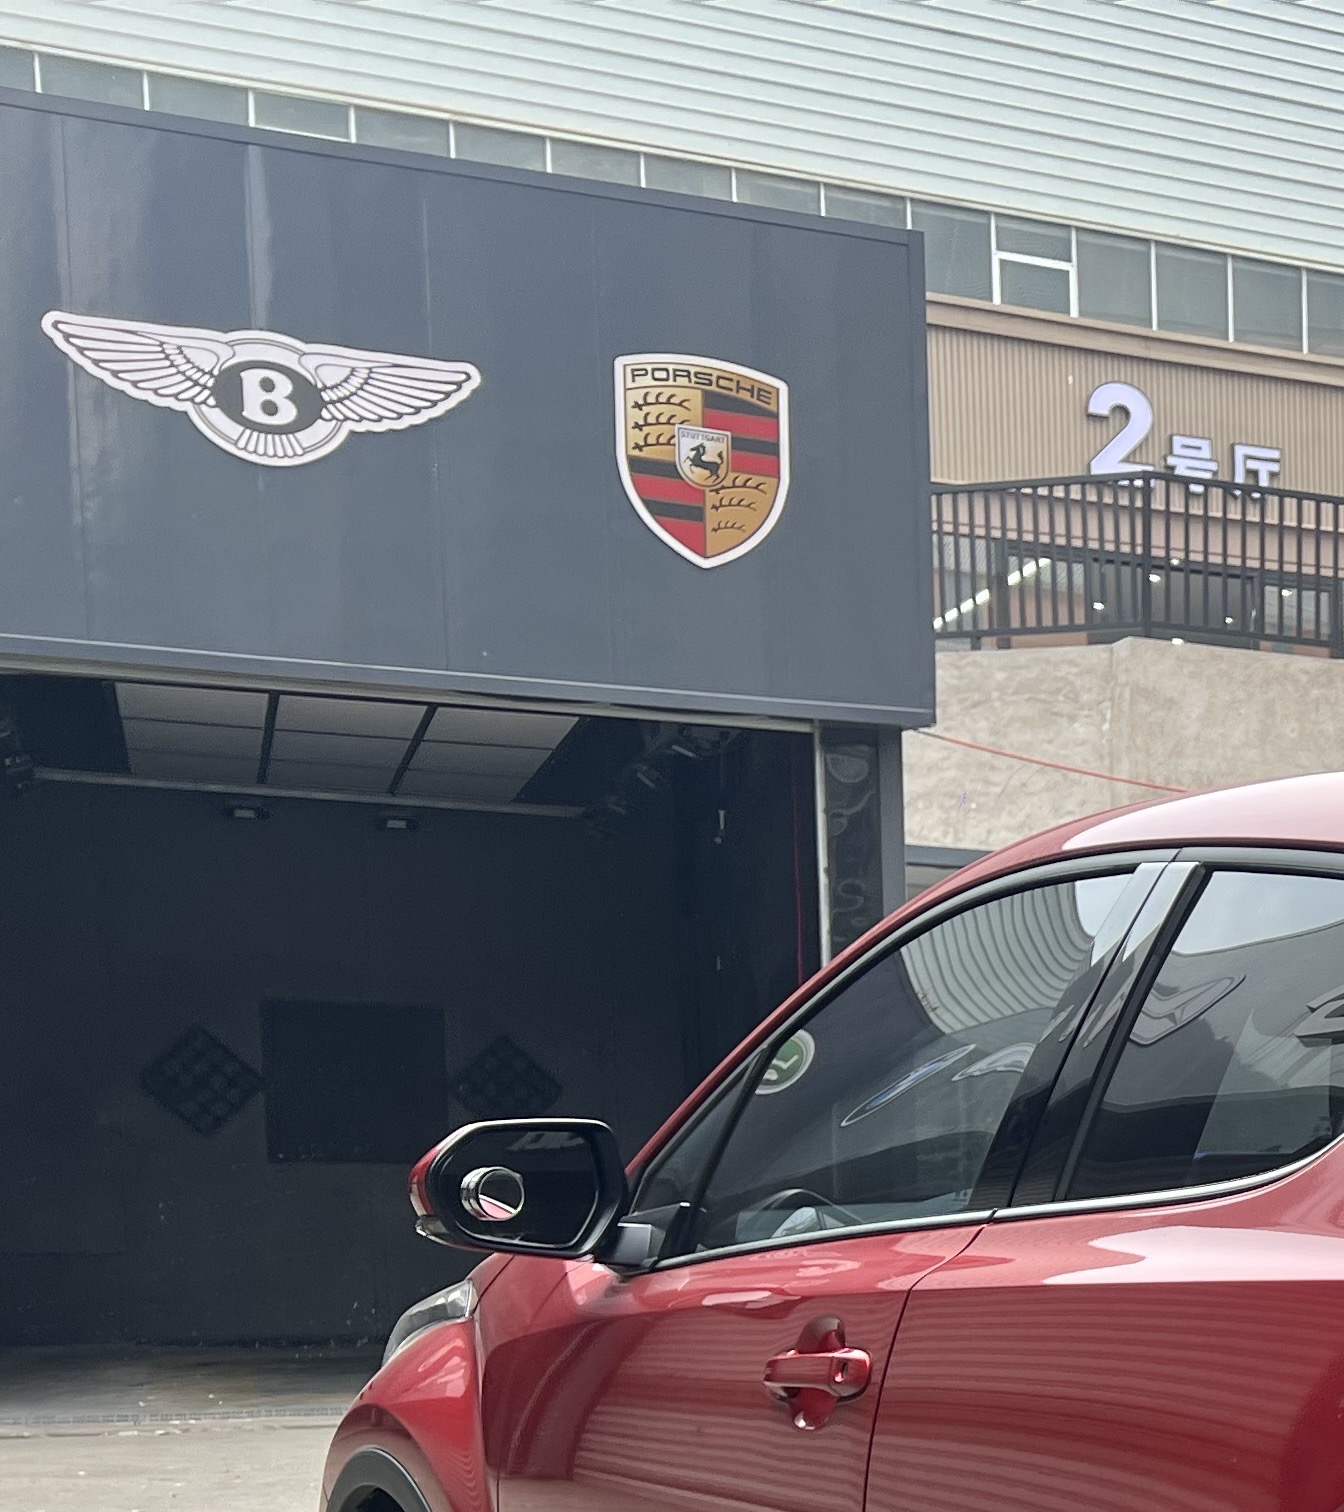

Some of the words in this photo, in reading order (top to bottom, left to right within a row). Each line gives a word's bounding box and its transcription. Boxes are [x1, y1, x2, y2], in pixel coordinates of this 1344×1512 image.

[239, 368, 298, 426] B
[630, 367, 772, 406] PORSCHE
[679, 430, 726, 444] STUTTGART
[1086, 381, 1282, 499] 2号厅
